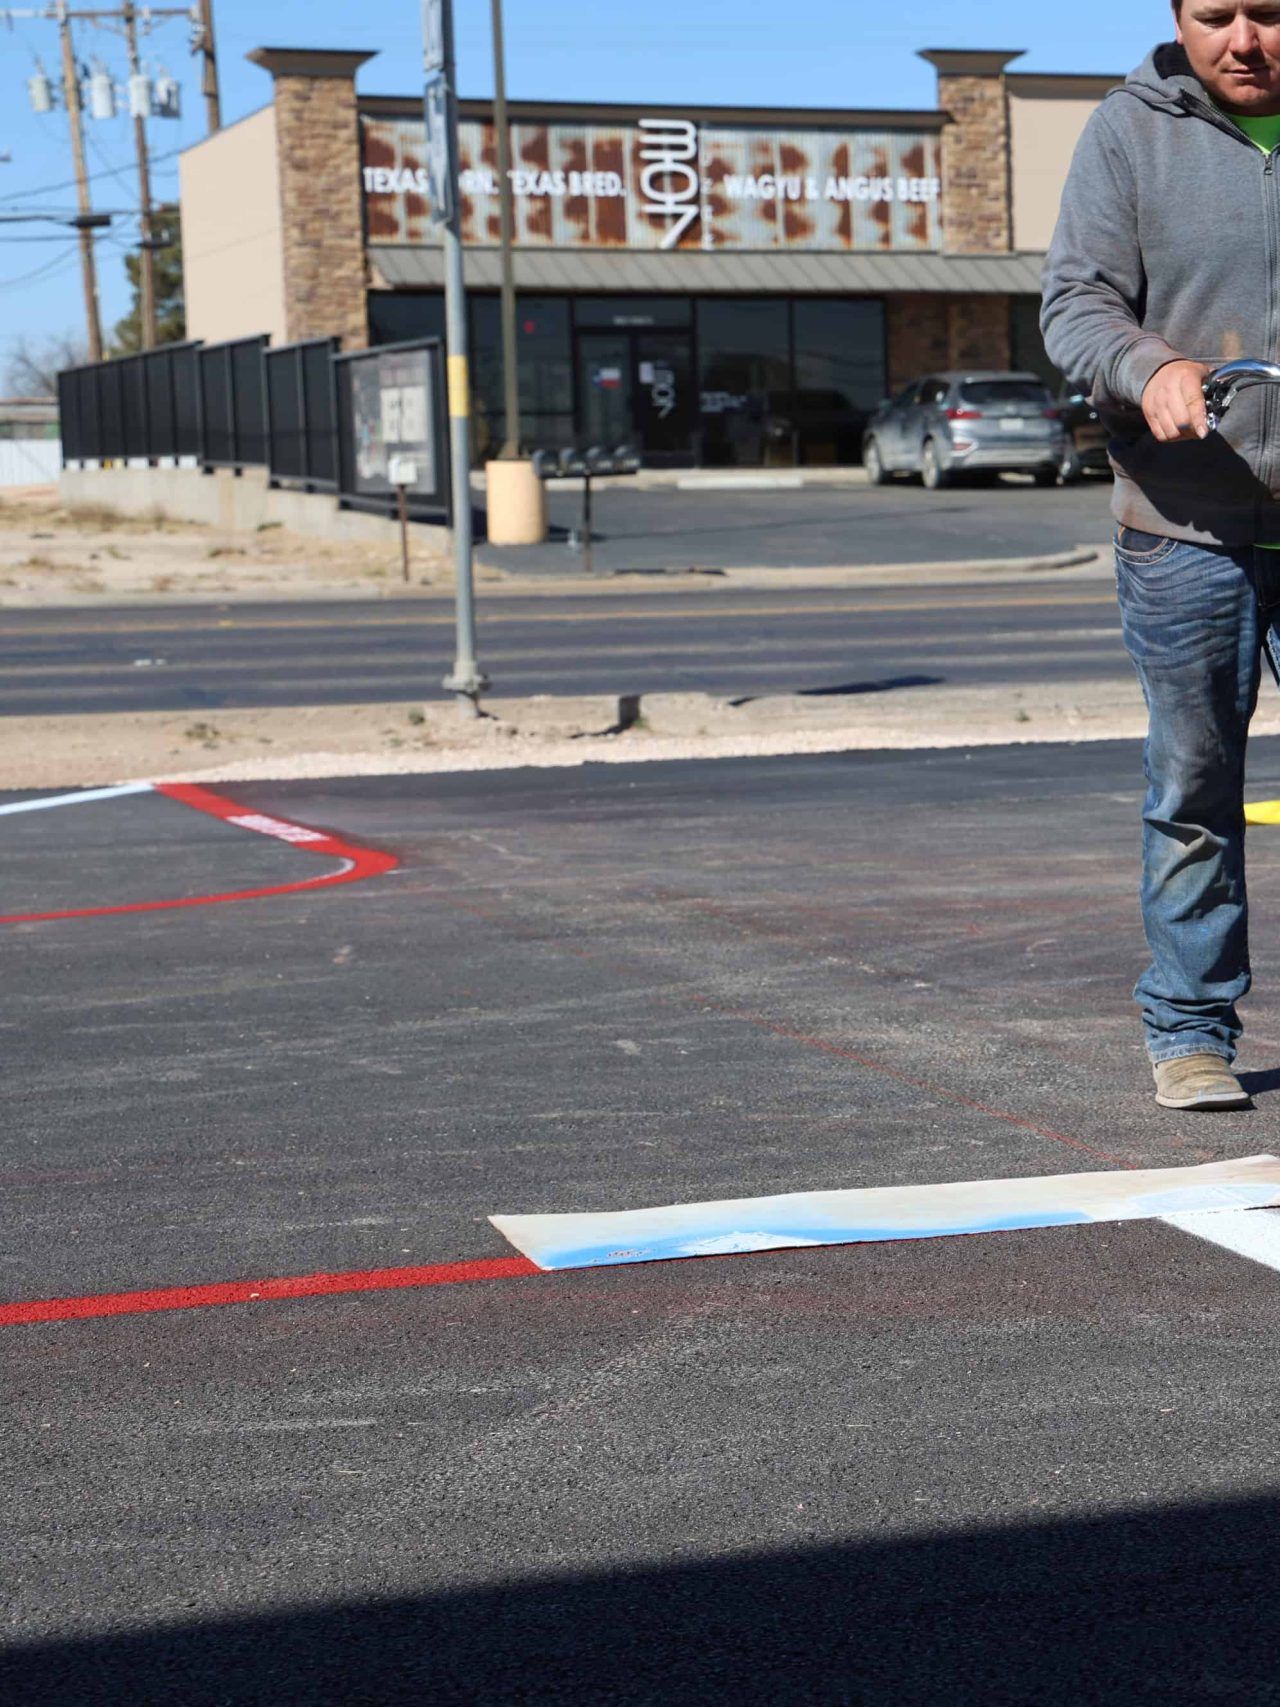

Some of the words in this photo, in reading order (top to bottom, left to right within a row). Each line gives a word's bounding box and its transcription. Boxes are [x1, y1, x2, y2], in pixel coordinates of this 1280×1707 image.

[363, 166, 429, 193] TEXAS
[723, 174, 800, 200] WAGYU
[825, 176, 893, 201] ANGUS
[897, 177, 940, 202] BEEF
